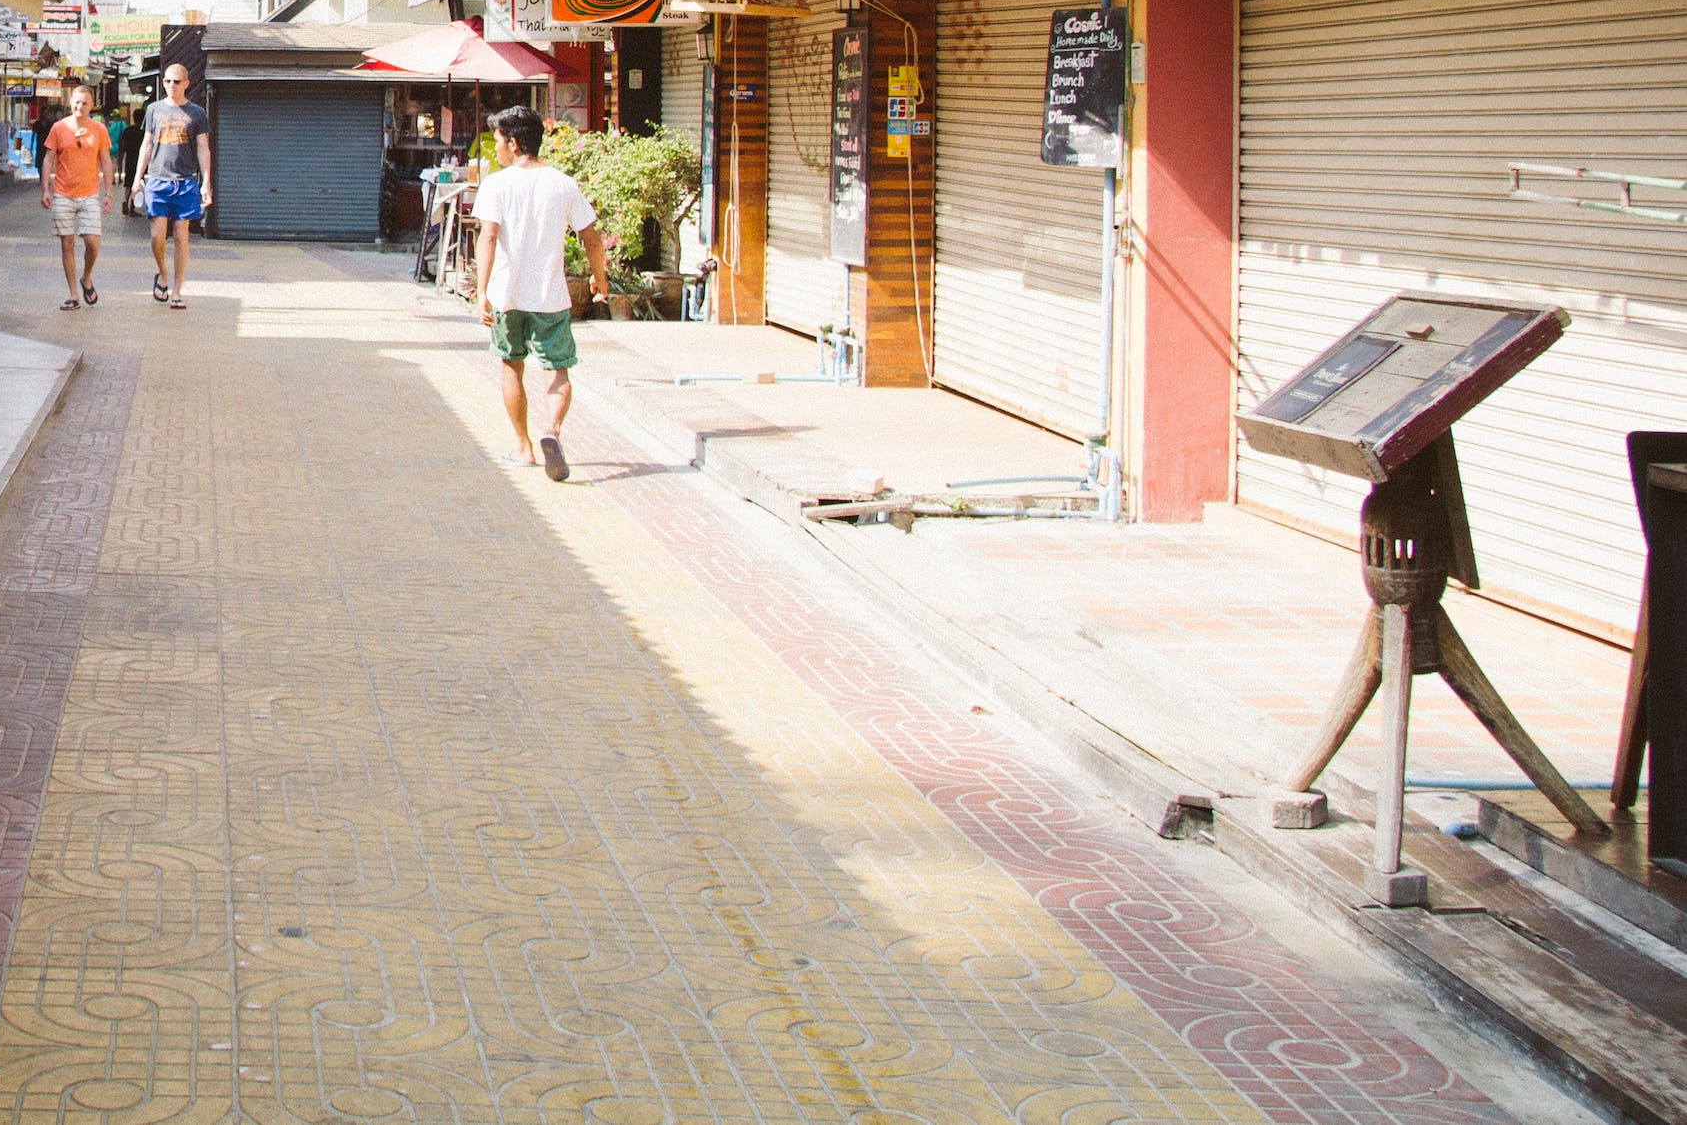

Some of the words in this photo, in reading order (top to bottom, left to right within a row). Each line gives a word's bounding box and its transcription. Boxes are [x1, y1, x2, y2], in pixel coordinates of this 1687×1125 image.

[1064, 12, 1102, 34] Cosmic
[1099, 28, 1118, 49] Daily
[1053, 50, 1099, 71] Breakfast
[1052, 72, 1085, 88] Brunch
[1049, 89, 1077, 105] Lunch
